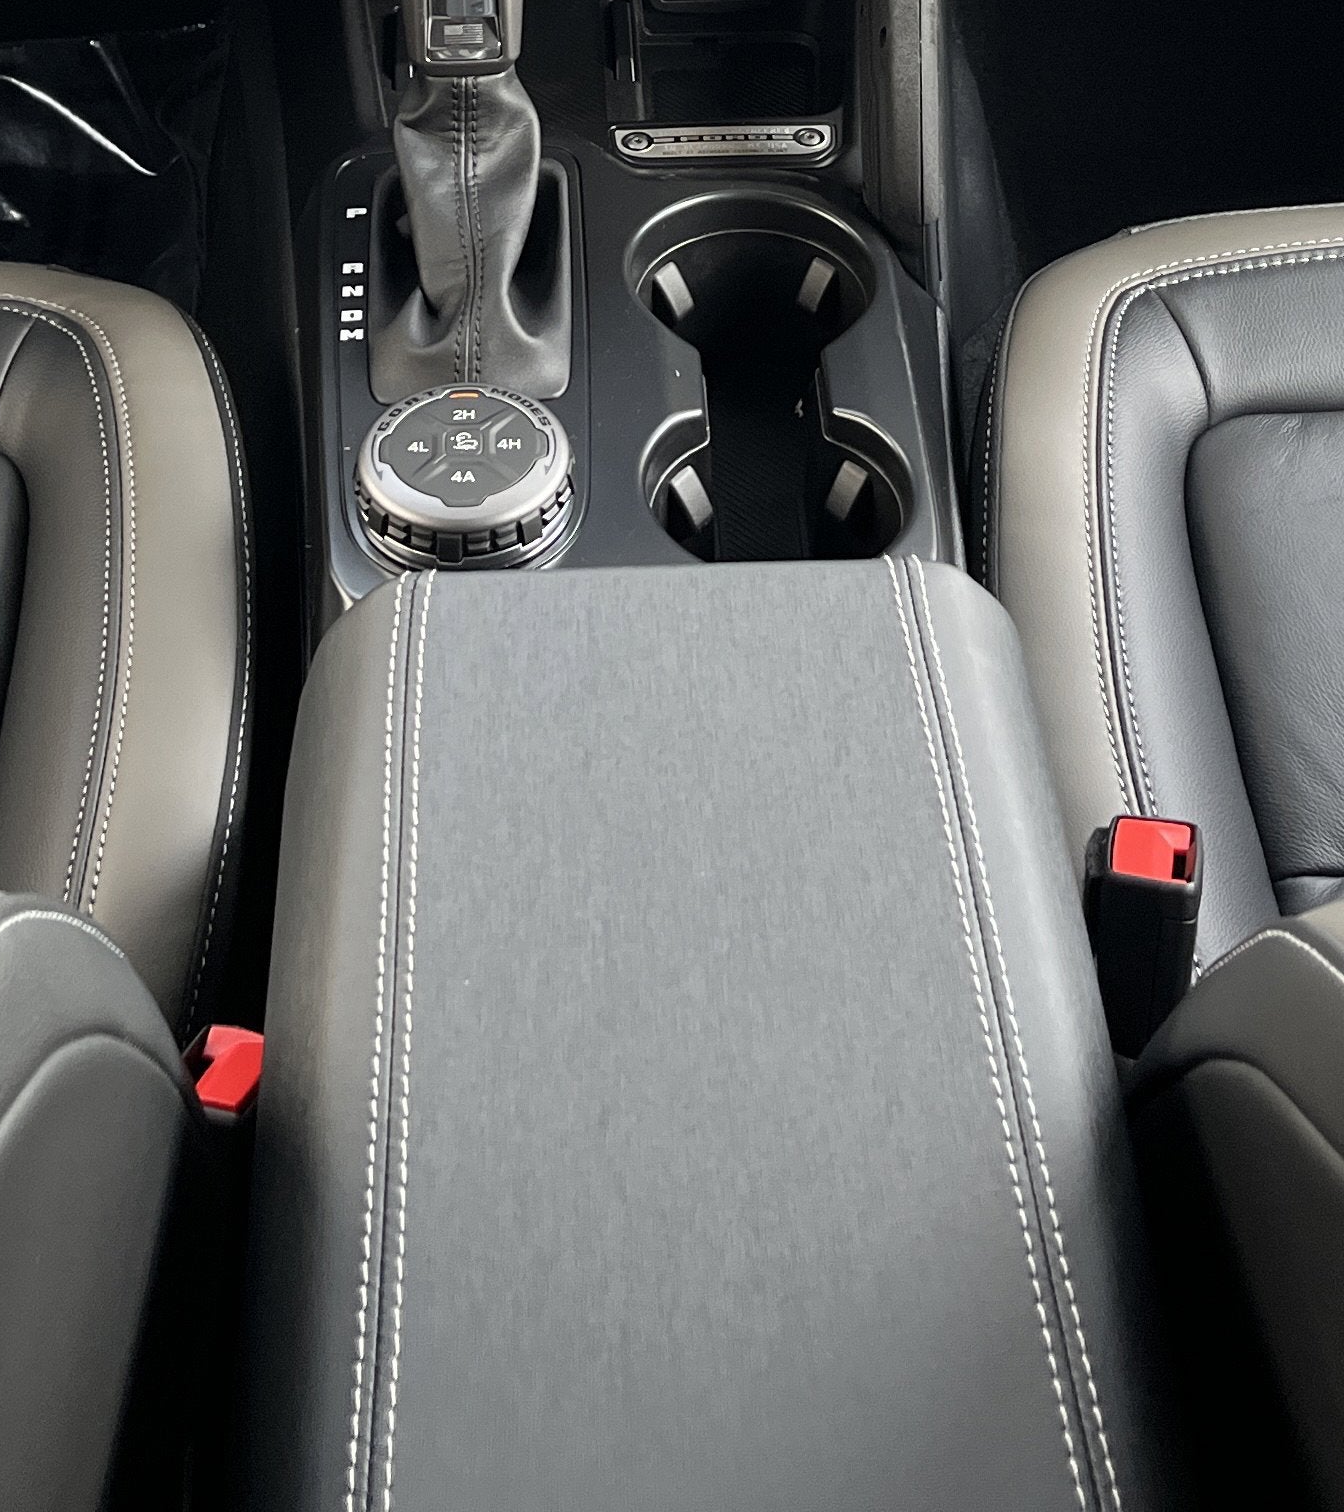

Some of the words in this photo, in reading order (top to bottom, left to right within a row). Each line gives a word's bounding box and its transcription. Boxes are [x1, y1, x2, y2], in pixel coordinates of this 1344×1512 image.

[346, 207, 367, 218] P
[342, 262, 364, 274] R
[341, 285, 364, 297] N
[339, 328, 364, 341] M
[491, 388, 552, 427] MODES
[452, 409, 476, 421] 2H
[407, 441, 430, 453] 4L
[496, 438, 522, 450] 4H
[450, 470, 476, 483] 4A
